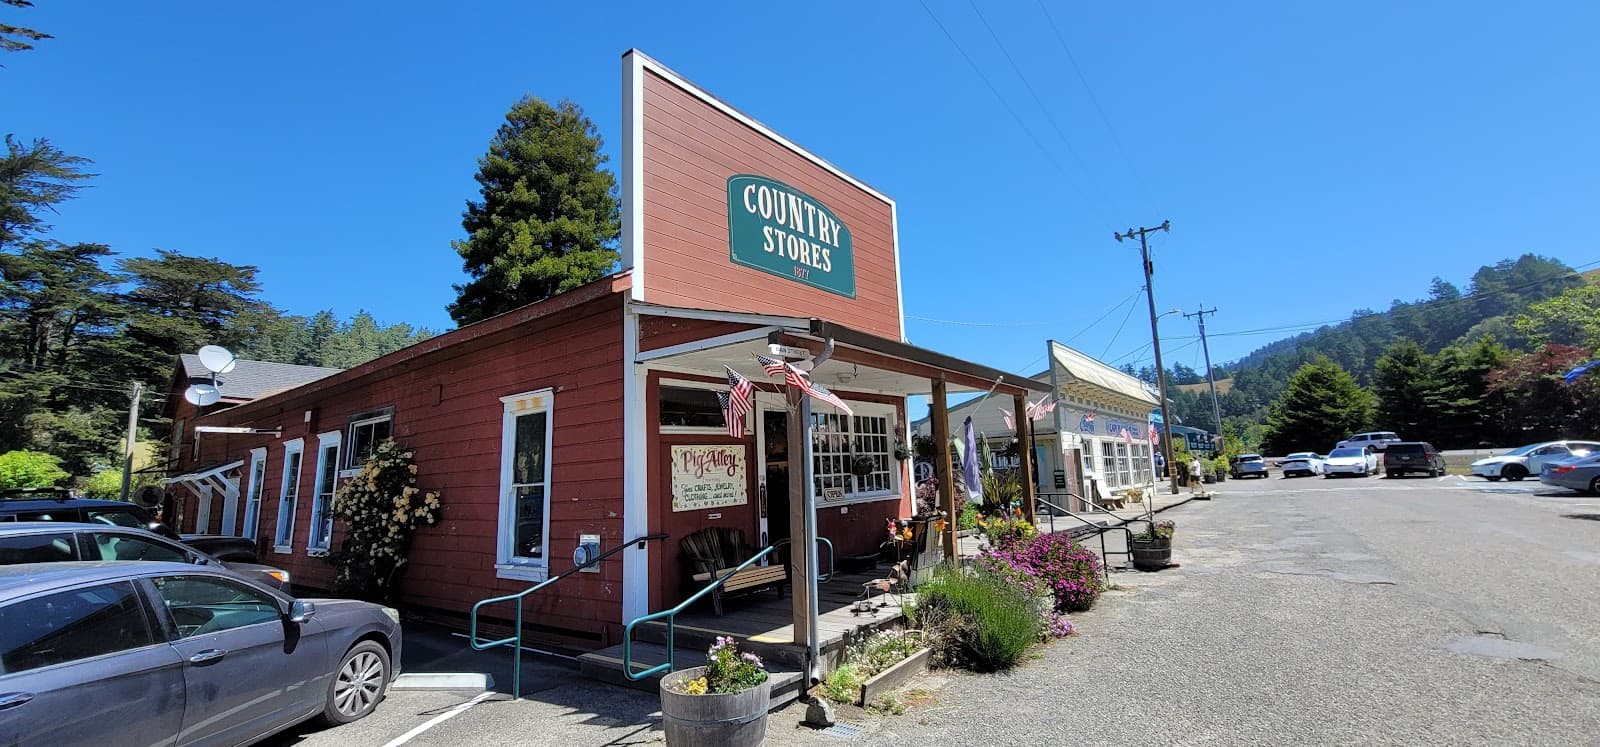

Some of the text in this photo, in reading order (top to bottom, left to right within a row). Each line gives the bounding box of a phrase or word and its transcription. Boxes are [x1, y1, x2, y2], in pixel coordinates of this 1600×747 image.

[743, 183, 841, 248] COUNTRY
[763, 225, 831, 273] STORES
[794, 266, 809, 280] 1877
[681, 450, 739, 479] Pig Alley
[827, 489, 843, 498] OPEN
